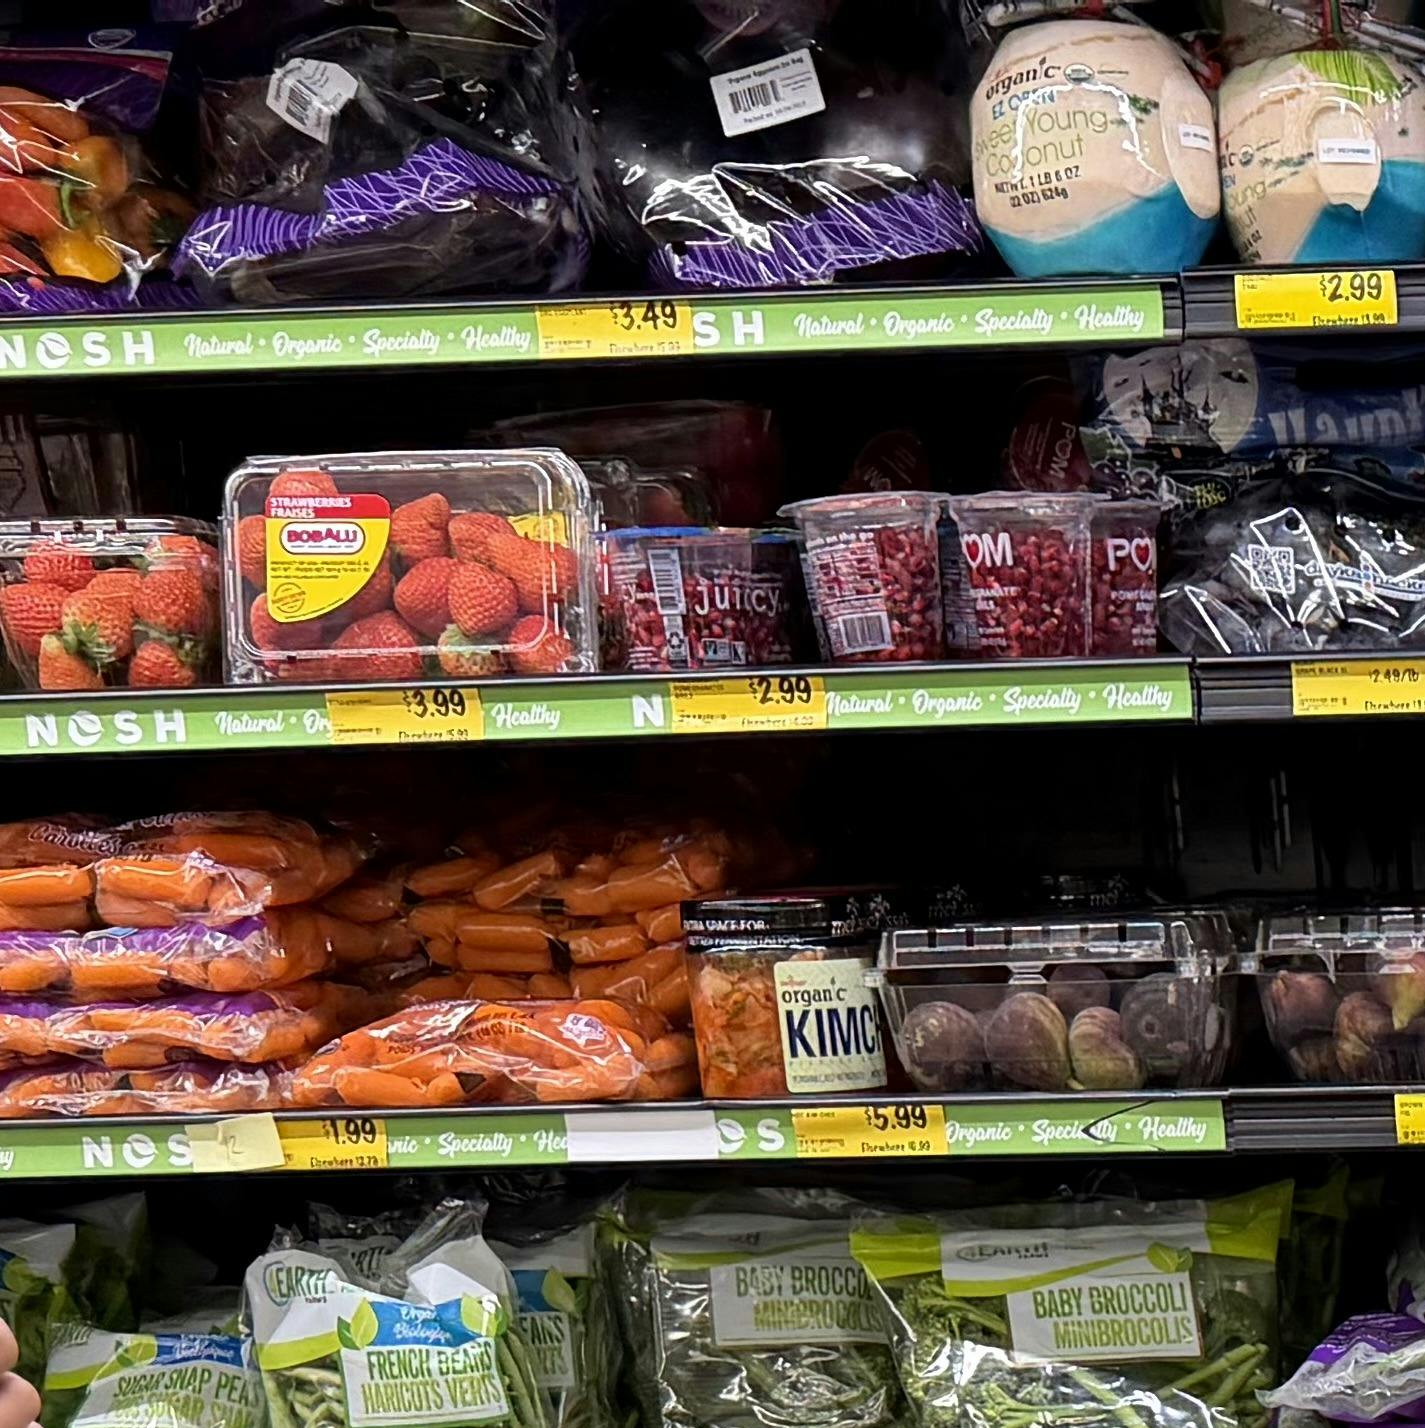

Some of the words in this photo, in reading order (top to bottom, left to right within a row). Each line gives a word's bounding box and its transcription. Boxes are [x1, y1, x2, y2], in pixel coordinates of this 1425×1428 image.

[985, 57, 1061, 100] organic
[1026, 109, 1108, 136] Young
[1320, 272, 1383, 302] $2.99
[609, 301, 677, 331] $3.49
[793, 313, 864, 338] Natural
[882, 307, 954, 337] Organic
[973, 305, 1053, 336] Specialty
[1075, 303, 1144, 332] Healthy
[0, 330, 155, 369] NOSH
[184, 332, 253, 356] Natural
[272, 330, 342, 358] Organic
[362, 327, 440, 357] Specialty
[461, 323, 530, 353] Healthy
[270, 497, 352, 509] STRAWBERRIES
[270, 507, 316, 519] FRAISES
[286, 529, 358, 544] BOBALU
[748, 676, 813, 705] $2.99
[1368, 668, 1420, 684] $2.49/lb
[402, 688, 466, 719] $3.99
[825, 690, 893, 716] Natural
[913, 688, 983, 717] Organic
[1003, 686, 1081, 715] Specialty
[1102, 682, 1172, 712] Healthy
[25, 709, 187, 747] NOSH
[215, 712, 285, 736] Natural
[491, 703, 561, 729] Healthy
[781, 977, 847, 1006] organic
[785, 1003, 883, 1060] KIMC
[320, 1117, 377, 1145] $1.99
[864, 1105, 928, 1132] $5.99
[946, 1119, 1012, 1146] Organic
[1138, 1113, 1207, 1142] Healthy
[437, 1128, 513, 1157] Specialty
[735, 1265, 787, 1298] BABY
[1032, 1286, 1083, 1320] BABY
[1088, 1281, 1188, 1317] BROCCOLI
[752, 1299, 883, 1334] MINIBROCOLIS
[1053, 1316, 1193, 1351] MINIBROCOLIS
[366, 1347, 432, 1381] FRENCH
[438, 1342, 493, 1376] BEANS
[113, 1368, 165, 1398] SUGAR
[164, 1366, 212, 1396] SNAP
[362, 1377, 443, 1415] HARICOTS
[444, 1373, 501, 1409] VERTS
